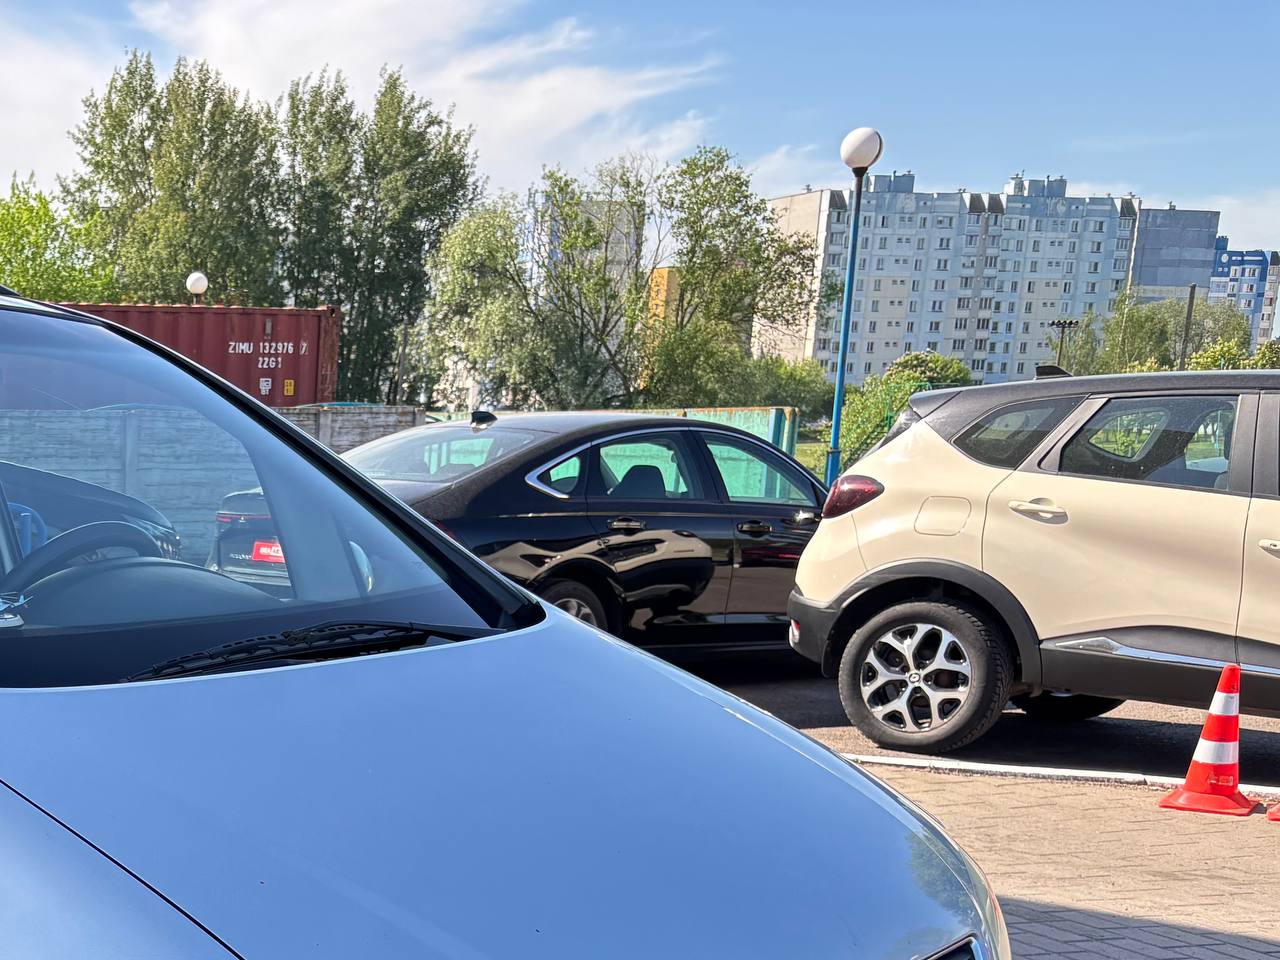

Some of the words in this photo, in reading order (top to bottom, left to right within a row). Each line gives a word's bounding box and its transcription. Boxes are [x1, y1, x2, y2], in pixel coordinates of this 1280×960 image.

[228, 342, 253, 354] ZIMU
[259, 342, 294, 354] 132976
[257, 357, 282, 369] 22G1
